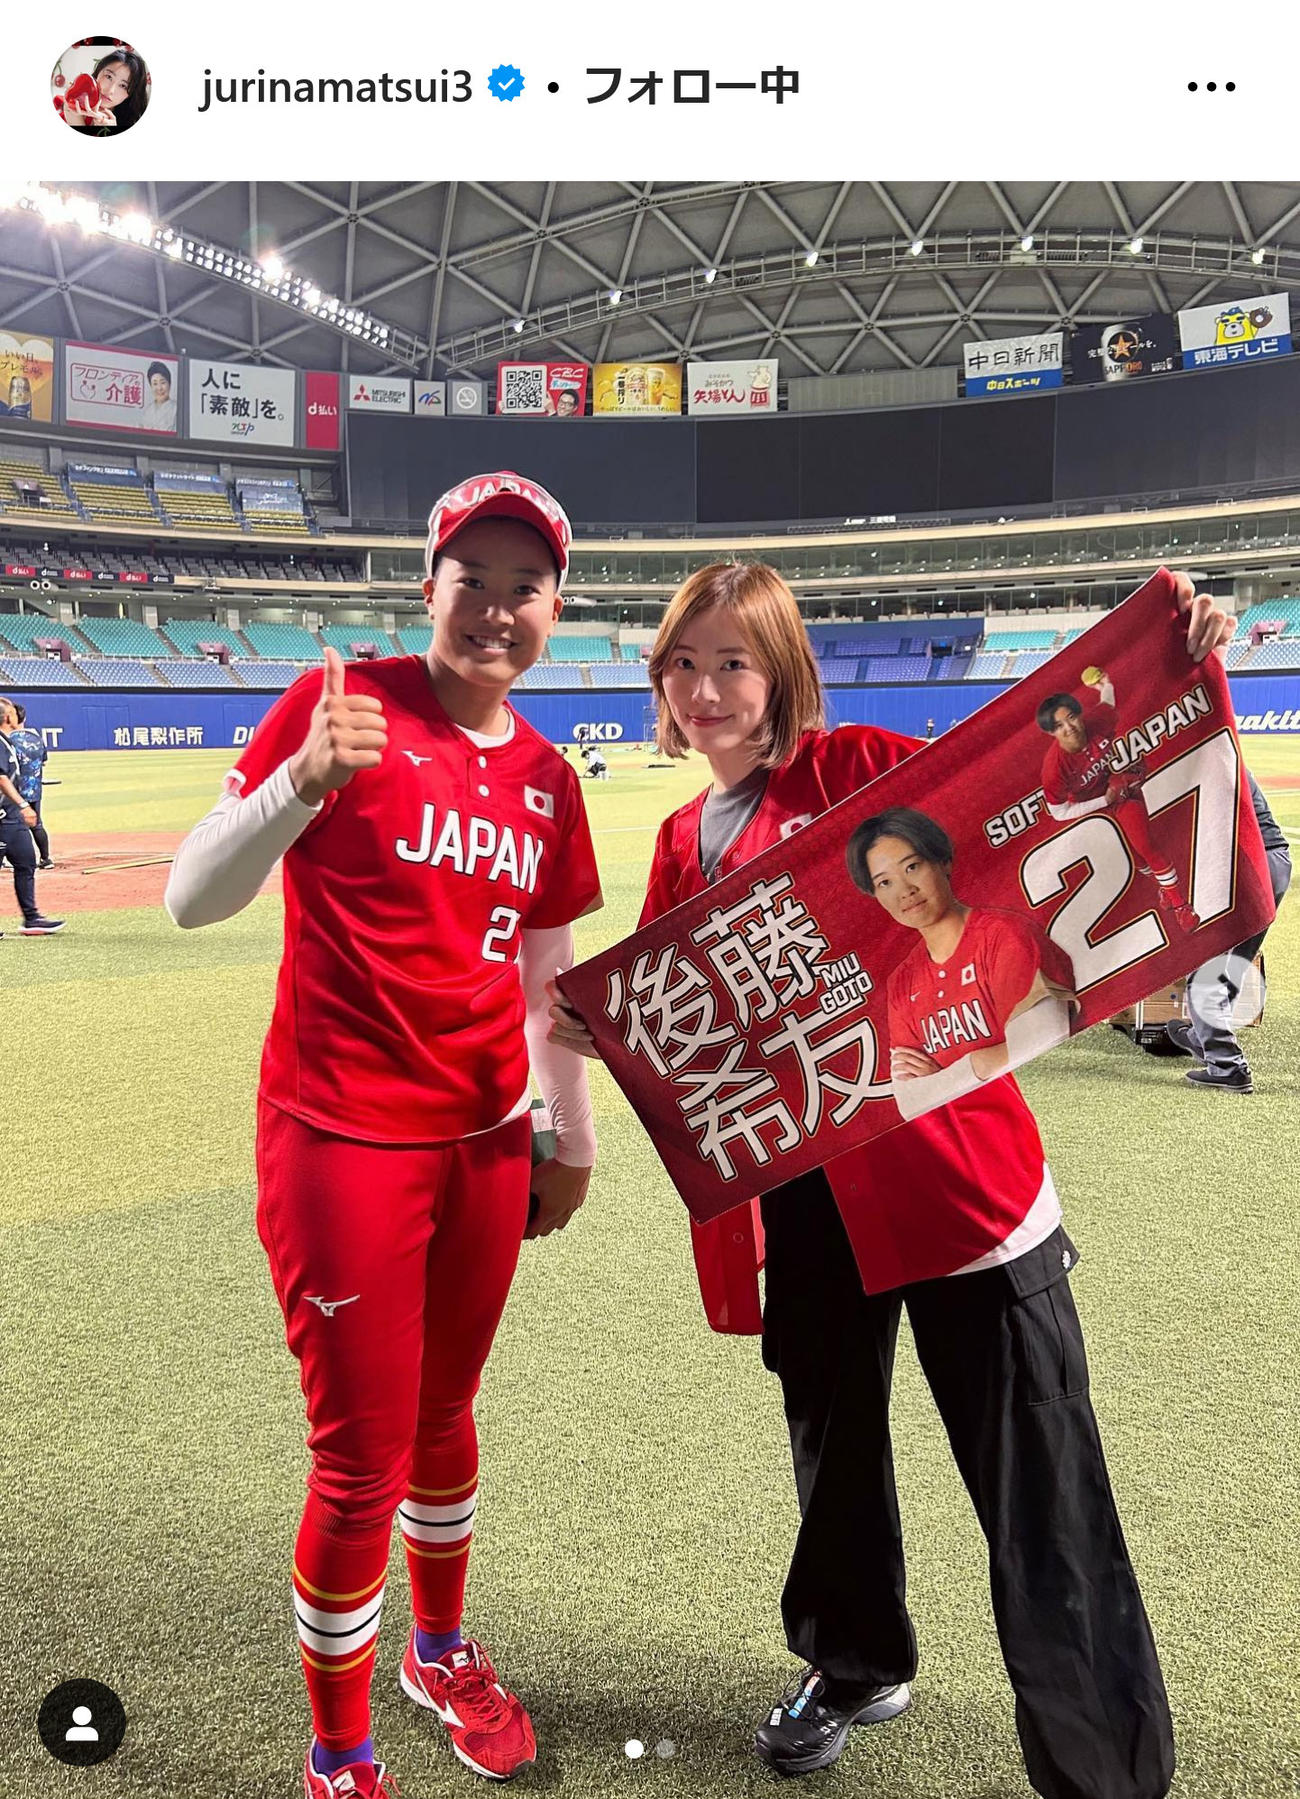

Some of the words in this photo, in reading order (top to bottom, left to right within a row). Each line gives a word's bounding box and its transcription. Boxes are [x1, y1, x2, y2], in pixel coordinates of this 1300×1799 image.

[968, 342, 1059, 371] 中日新聞
[1194, 339, 1279, 366] 東海テレビ
[106, 383, 142, 406] 介護
[201, 367, 242, 390] 人に
[986, 377, 1041, 392] 中日スポーツ
[200, 392, 285, 421] 「素敵」を。
[113, 726, 204, 747] 松尾製作所
[572, 722, 624, 741] CKD
[1110, 684, 1212, 773] JAPAN
[395, 803, 545, 895] JAPAN
[1019, 727, 1239, 996] 27
[604, 872, 831, 1088] 後藤
[820, 951, 862, 989] MIU
[819, 970, 874, 1014] GOTO
[921, 999, 992, 1055] JAPAN
[673, 996, 892, 1190] 希友
